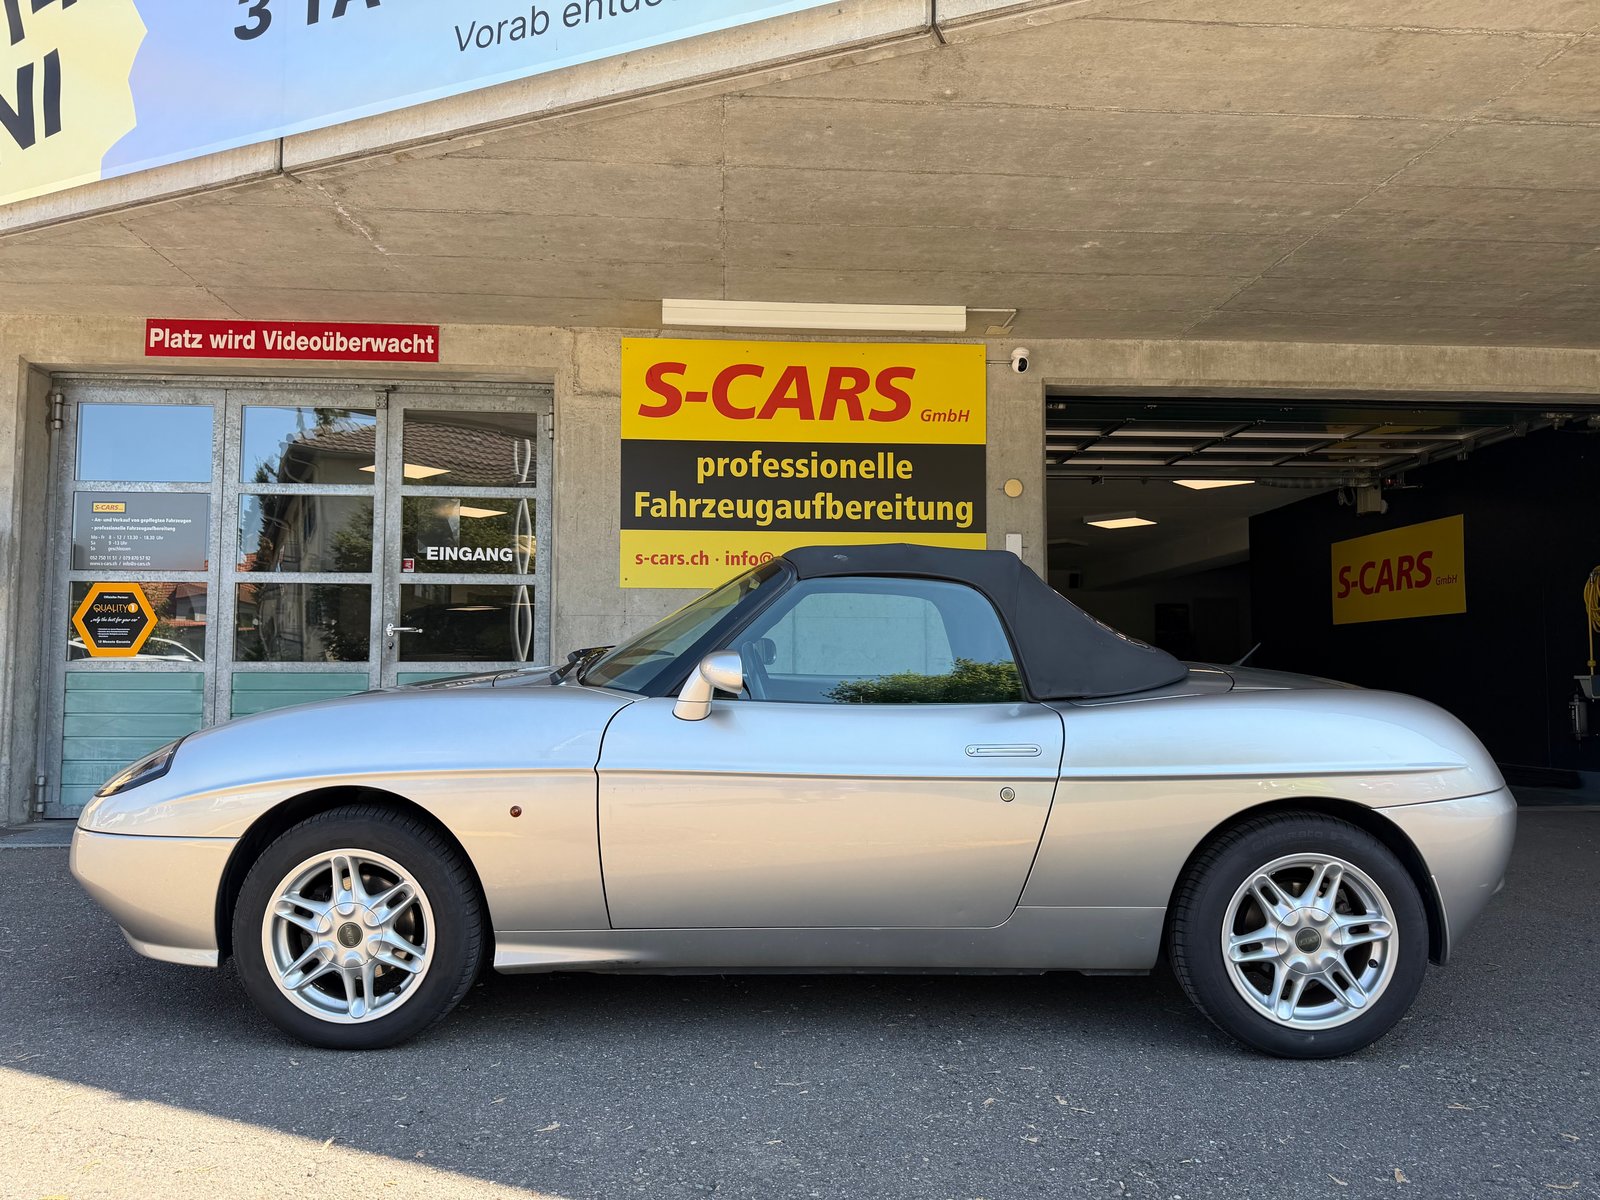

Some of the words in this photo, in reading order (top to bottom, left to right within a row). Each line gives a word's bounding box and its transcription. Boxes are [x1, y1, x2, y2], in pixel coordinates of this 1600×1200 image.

[453, 5, 550, 52] Vorab
[149, 327, 203, 349] Platz
[209, 329, 256, 350] wird
[262, 330, 435, 354] Videoüberwacht
[637, 361, 916, 423] S-CARS
[920, 408, 970, 423] GmbH
[696, 450, 913, 484] professionelle
[634, 490, 974, 528] Fahrzeugaufbereitung
[426, 546, 513, 562] EINGANG
[635, 550, 709, 566] s-cars.ch
[1337, 550, 1433, 599] S-CARS
[1435, 574, 1458, 586] GmbH
